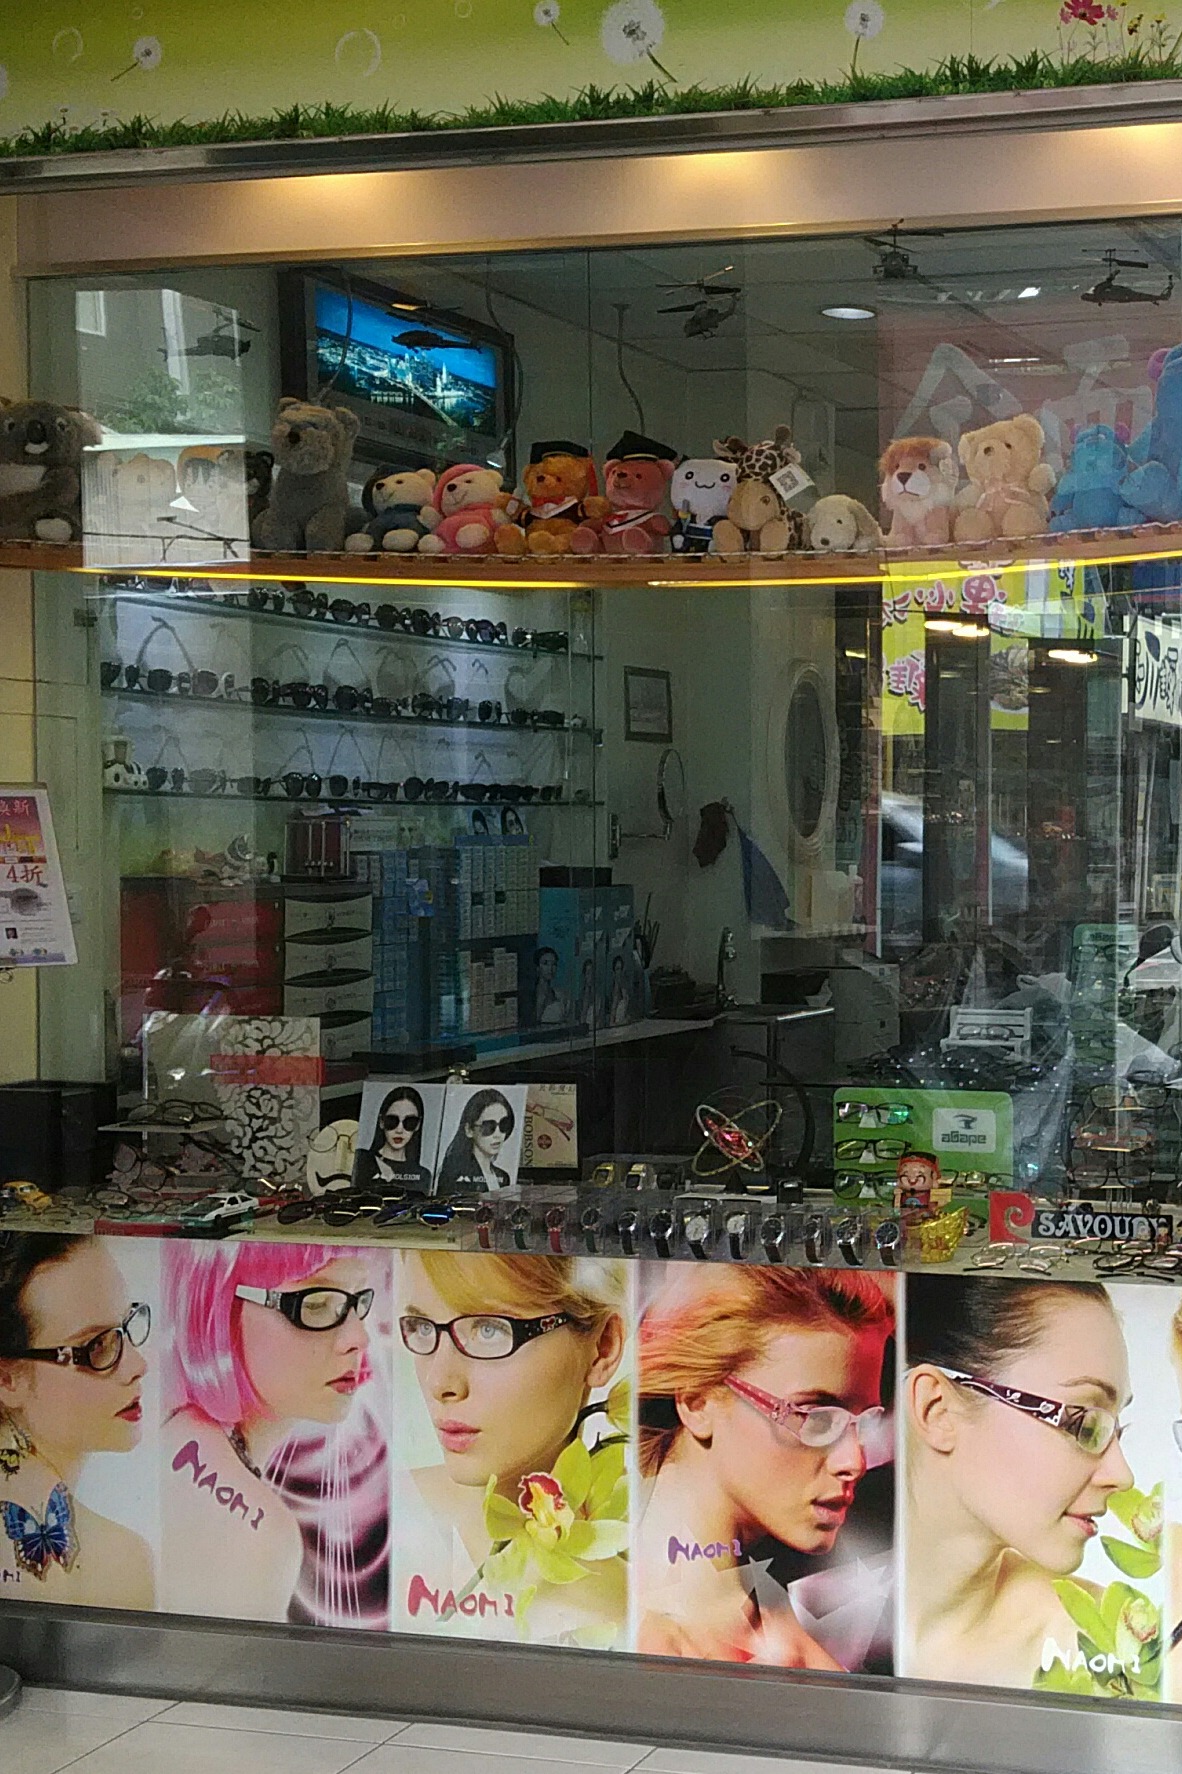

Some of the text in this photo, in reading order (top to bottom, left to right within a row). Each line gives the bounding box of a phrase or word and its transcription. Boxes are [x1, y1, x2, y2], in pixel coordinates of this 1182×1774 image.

[6, 864, 44, 883] 4折
[523, 1115, 534, 1168] BOBSON
[171, 1439, 265, 1531] NAOMI
[667, 1535, 743, 1565] NAOMI
[408, 1574, 515, 1618] NAOMI
[1040, 1637, 1142, 1674] NAOMI
